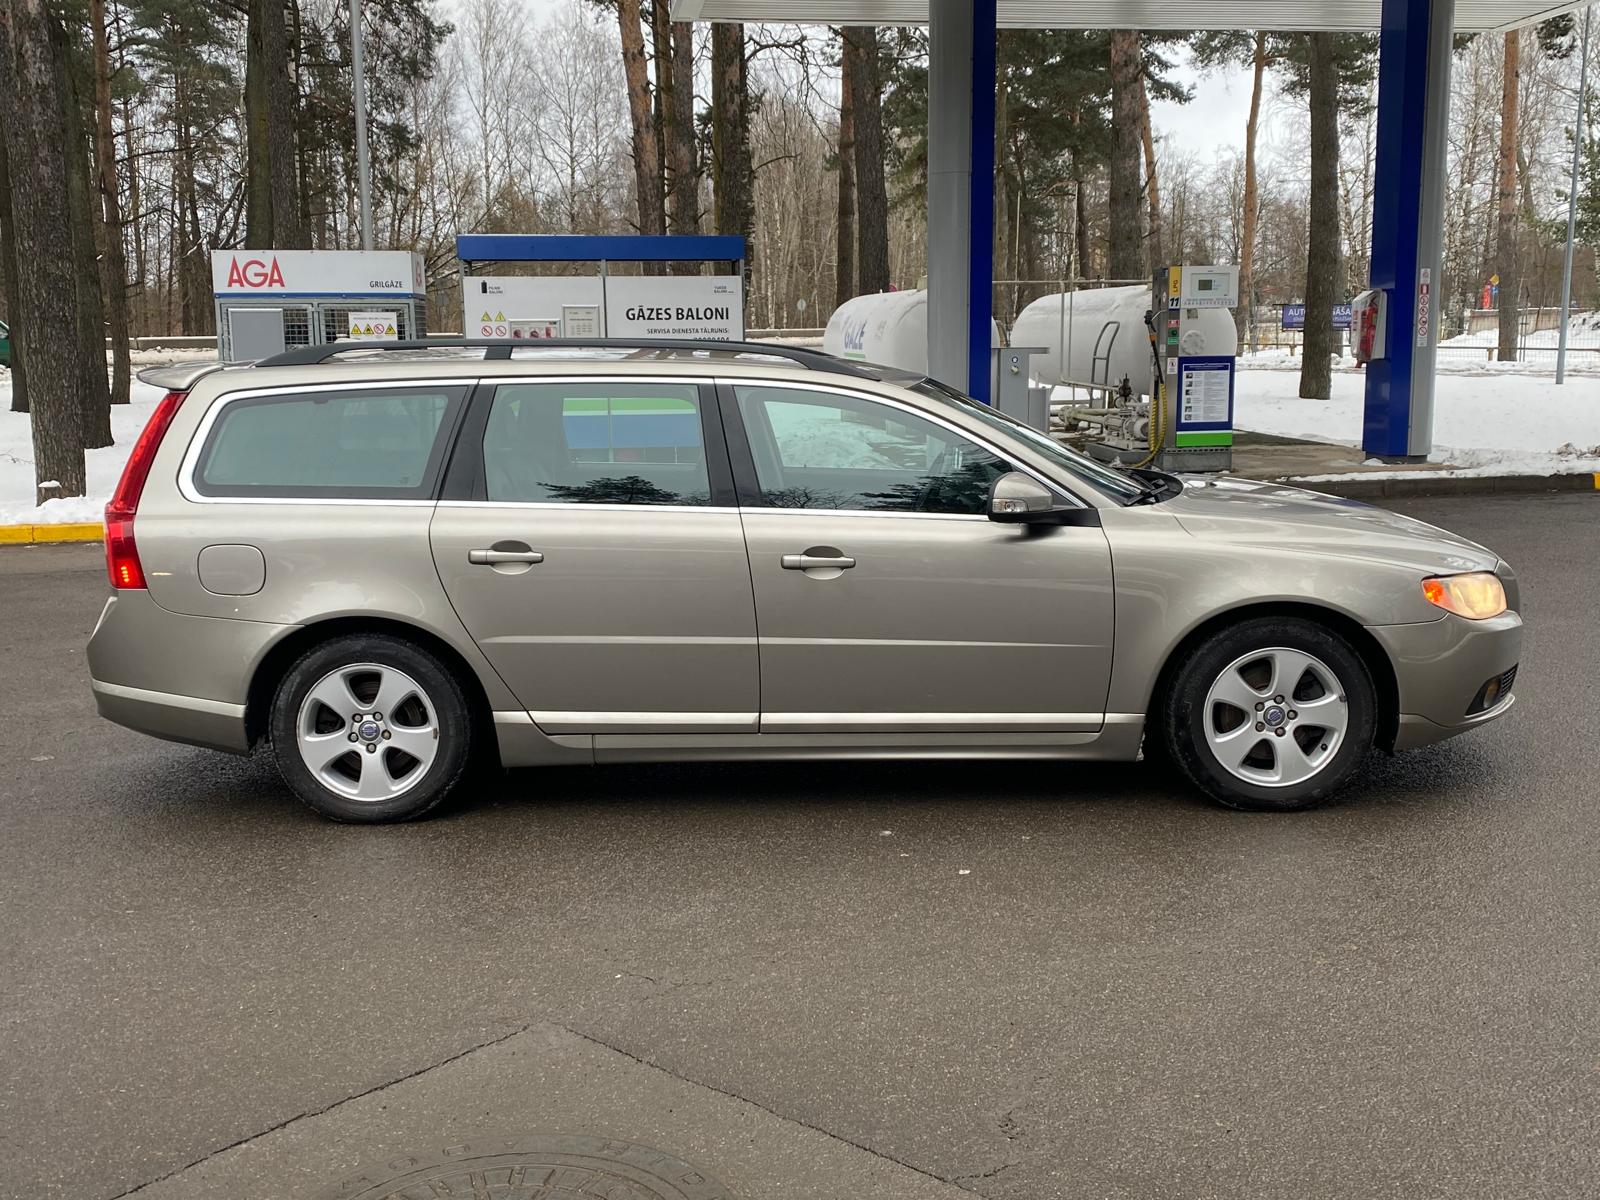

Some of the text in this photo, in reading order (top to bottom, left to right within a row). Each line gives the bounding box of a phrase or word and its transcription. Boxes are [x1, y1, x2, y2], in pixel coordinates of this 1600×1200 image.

[227, 255, 285, 288] AGA
[1169, 297, 1180, 307] 11
[626, 305, 729, 321] GĀZES BALONI
